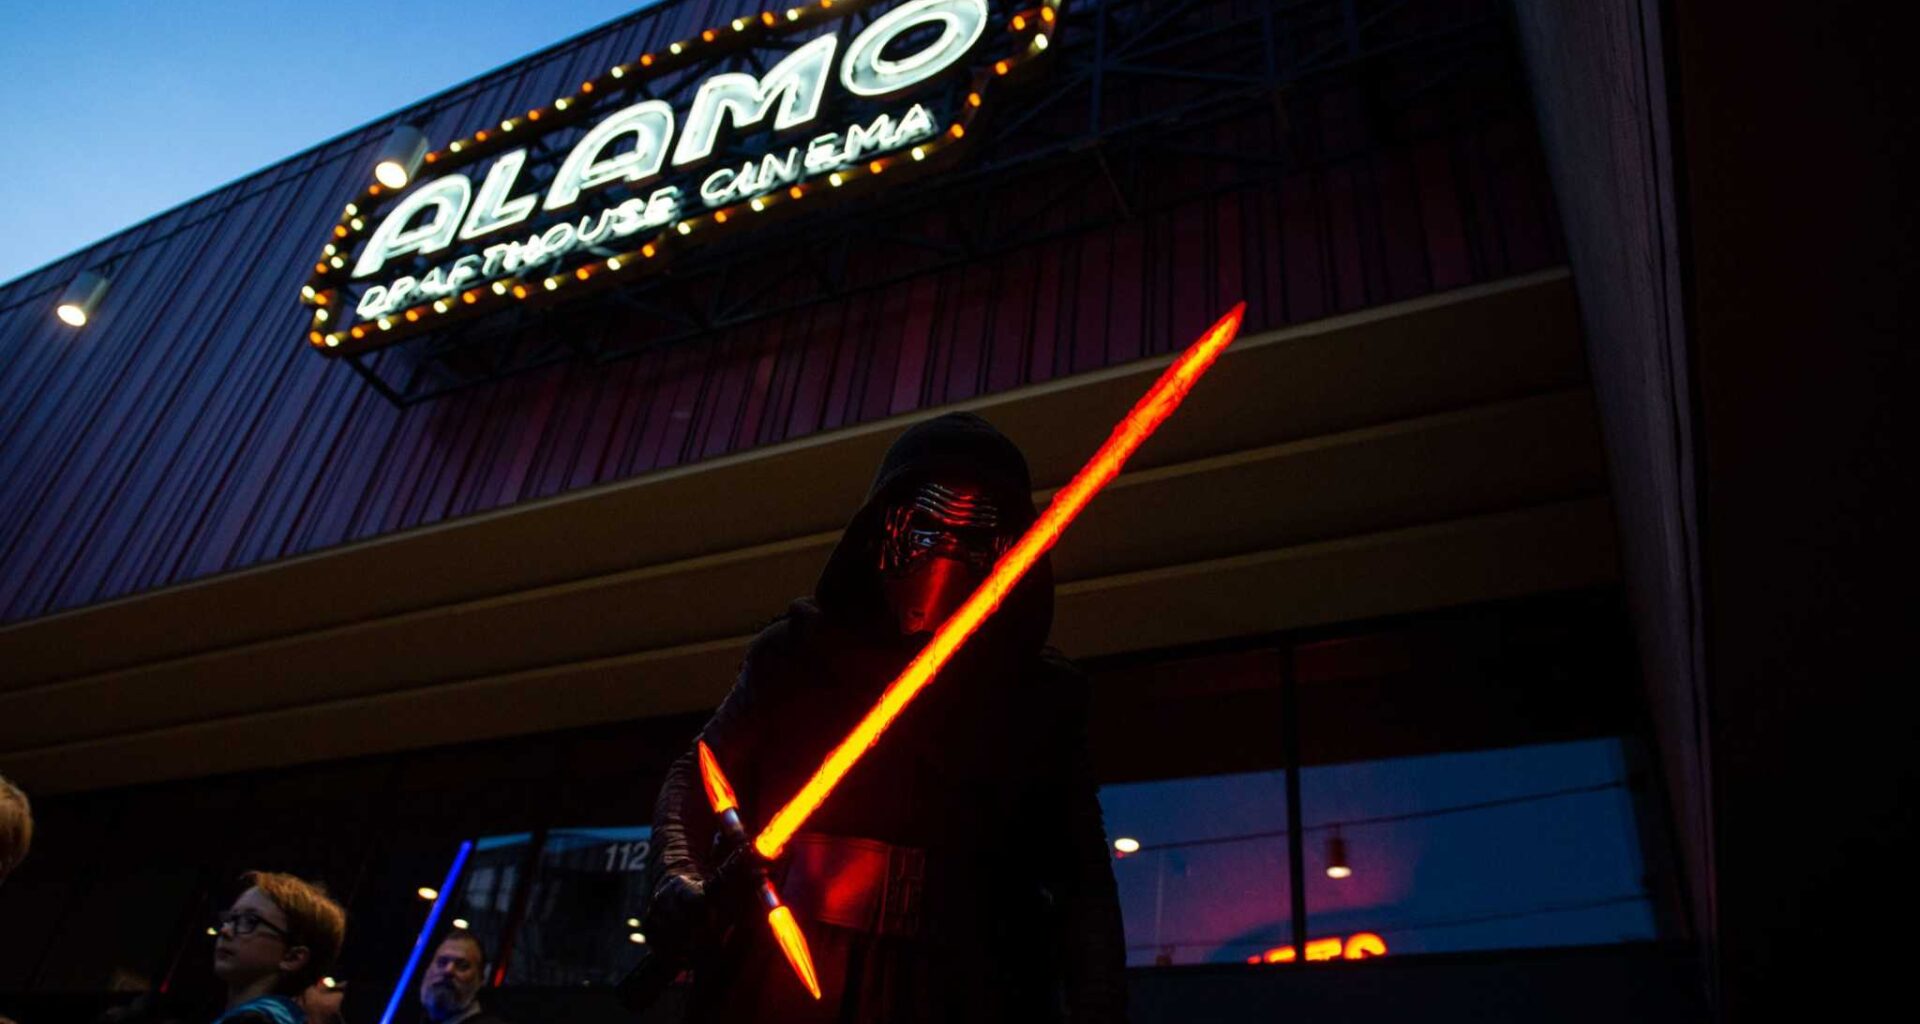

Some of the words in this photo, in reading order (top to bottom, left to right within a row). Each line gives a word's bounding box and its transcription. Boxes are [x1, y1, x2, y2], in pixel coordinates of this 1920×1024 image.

[351, 0, 988, 278] ALAMO
[356, 185, 683, 320] DRAFTHOUSE
[700, 103, 935, 207] CINEMA
